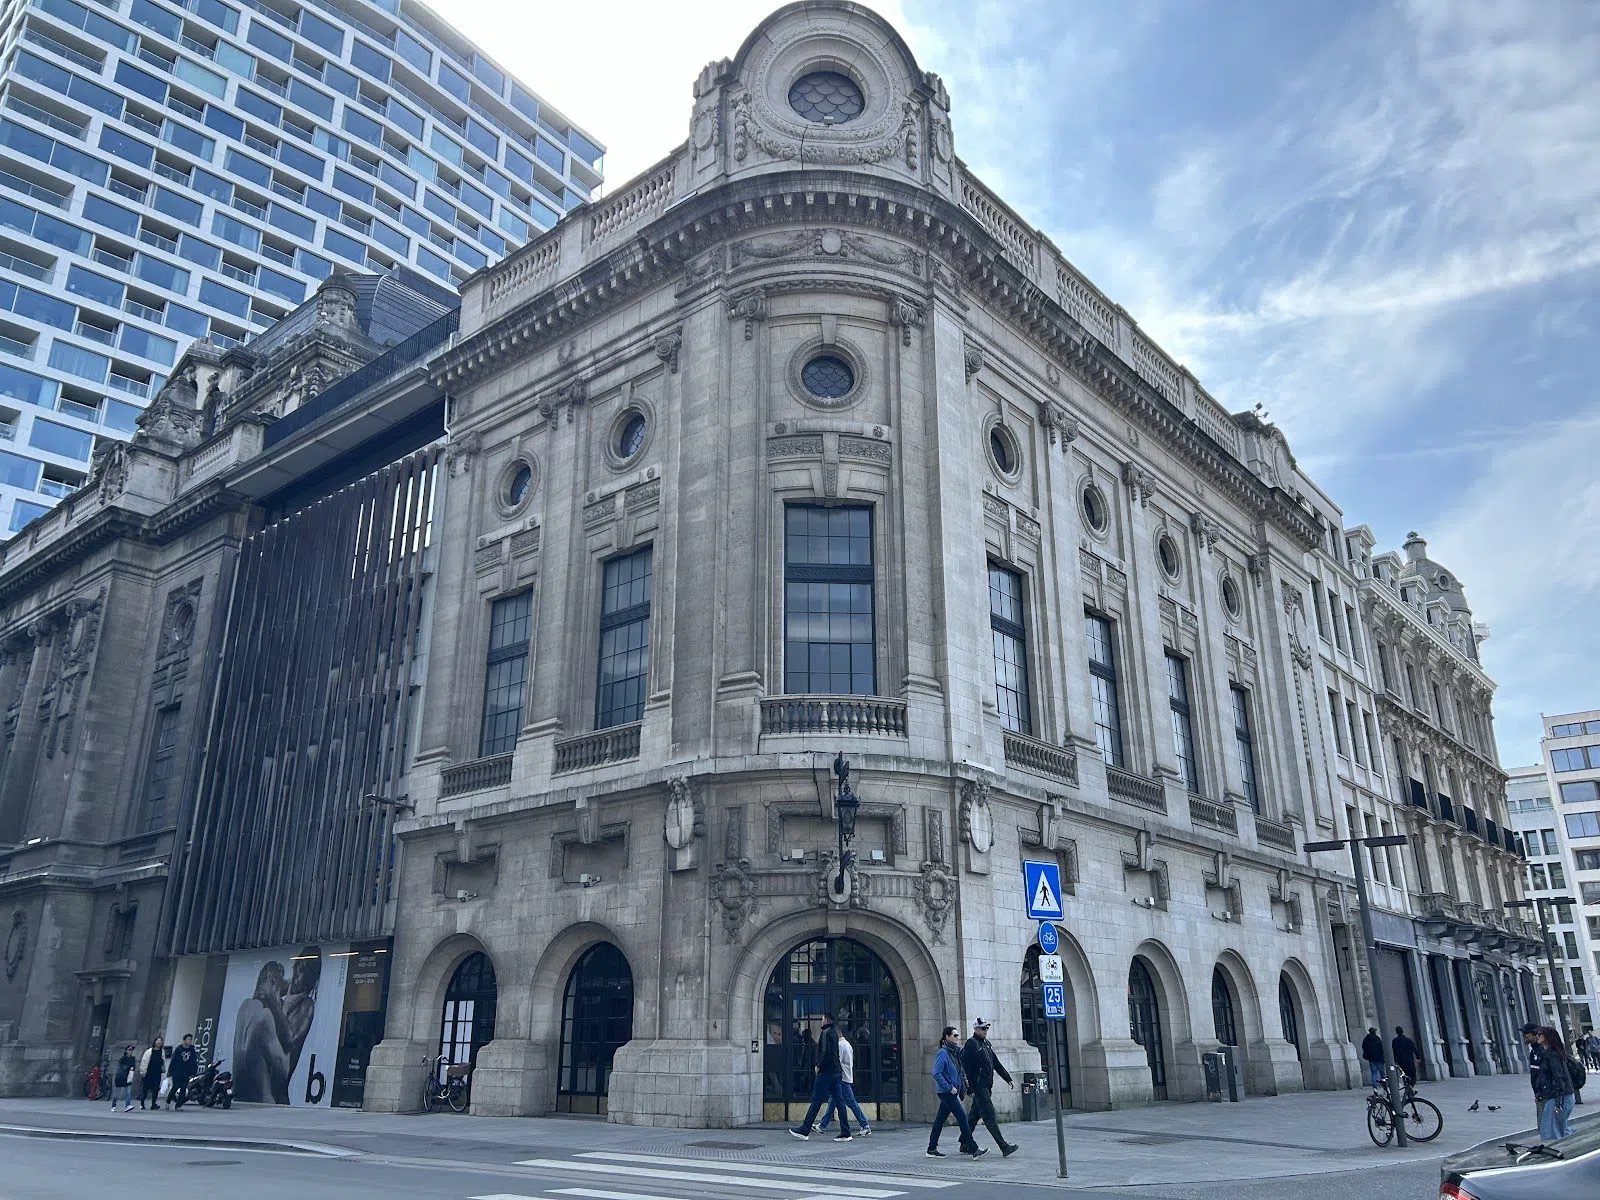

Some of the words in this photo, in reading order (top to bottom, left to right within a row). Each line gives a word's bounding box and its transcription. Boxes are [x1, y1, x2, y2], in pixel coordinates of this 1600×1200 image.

[1047, 988, 1061, 1003] 25
[197, 1018, 213, 1075] ROME
[304, 1053, 327, 1105] b
